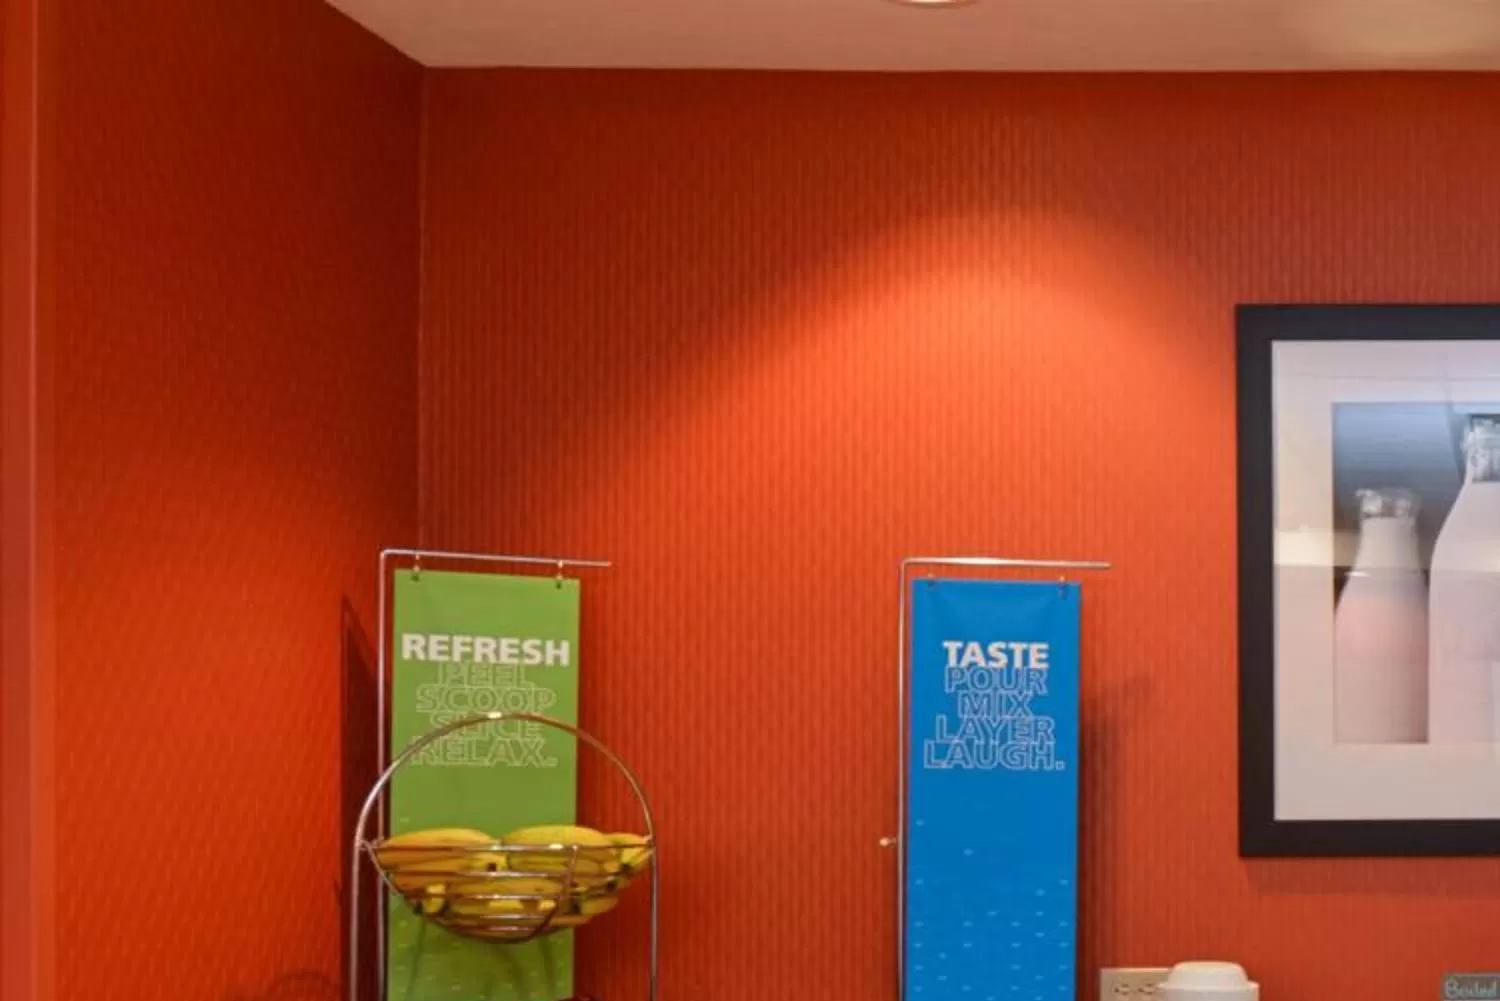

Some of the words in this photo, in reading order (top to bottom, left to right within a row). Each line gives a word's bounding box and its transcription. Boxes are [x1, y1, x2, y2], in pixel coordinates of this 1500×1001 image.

[401, 633, 571, 666] REFRESH
[942, 640, 1049, 669] TASTE
[438, 660, 537, 688] PEEL
[944, 665, 1048, 695] POUR
[415, 684, 558, 713] SCOOP
[957, 690, 1034, 719] MIX
[936, 714, 1057, 744] LAYER
[923, 739, 1066, 770] LAUGH.
